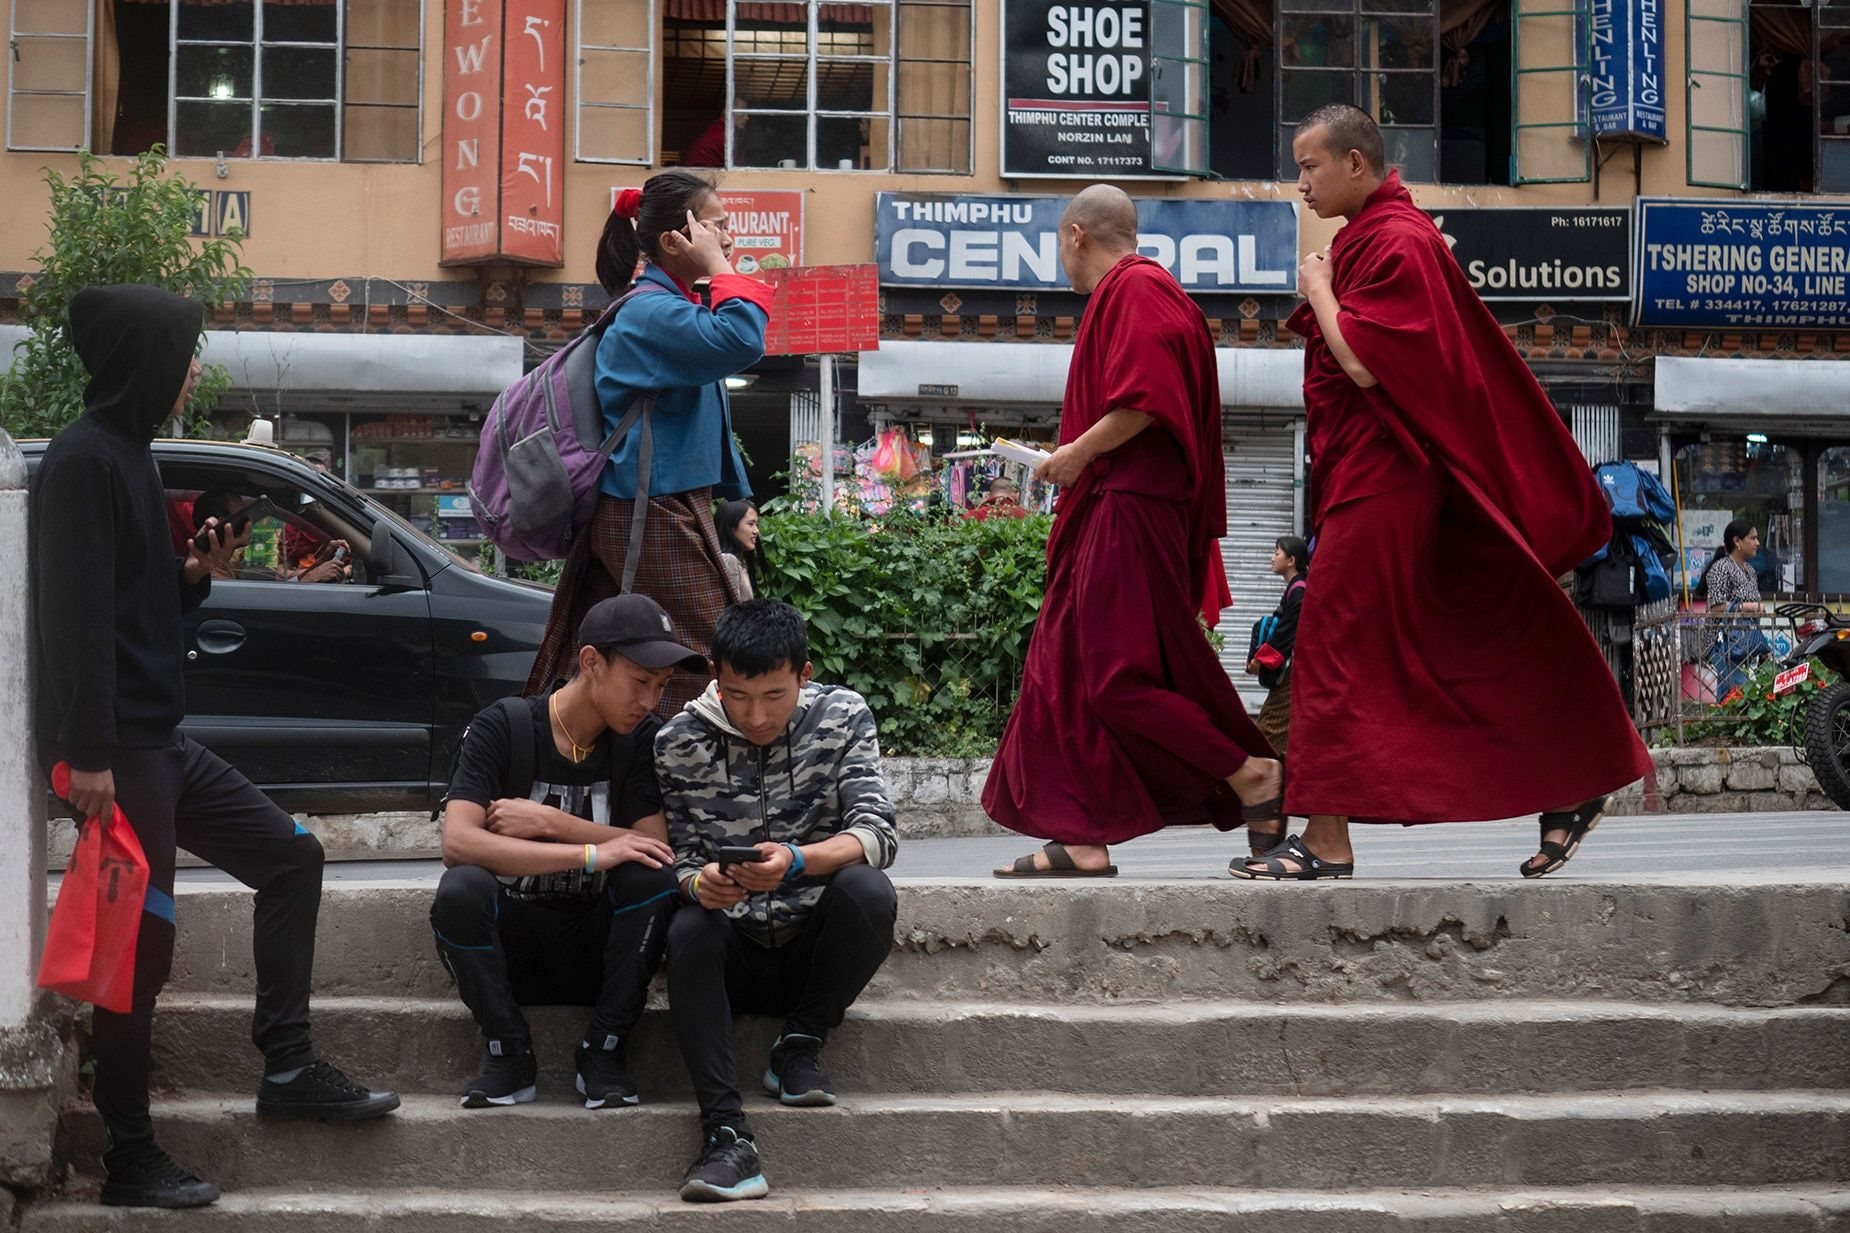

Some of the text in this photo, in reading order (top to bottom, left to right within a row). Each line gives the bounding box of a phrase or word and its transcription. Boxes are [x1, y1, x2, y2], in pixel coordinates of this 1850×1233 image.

[1047, 5, 1143, 48] SHOE
[1047, 53, 1143, 95] SHOP
[1008, 111, 1057, 126] THIMPHU
[1059, 113, 1102, 127] CENTER
[1057, 132, 1104, 143] NORZIN
[1048, 155, 1143, 166] CONT NO. 17117373
[892, 201, 1032, 224] THIMPHU
[1551, 217, 1622, 227] Ph: 16171617
[738, 238, 757, 247] PURE
[1648, 244, 1762, 272] TSHERING
[1468, 258, 1621, 288] Solutions
[1687, 274, 1845, 298] SHOP NO-34, LINE
[1655, 299, 1685, 310] TEL
[1690, 300, 1699, 310] #
[1705, 301, 1766, 311] 334417,
